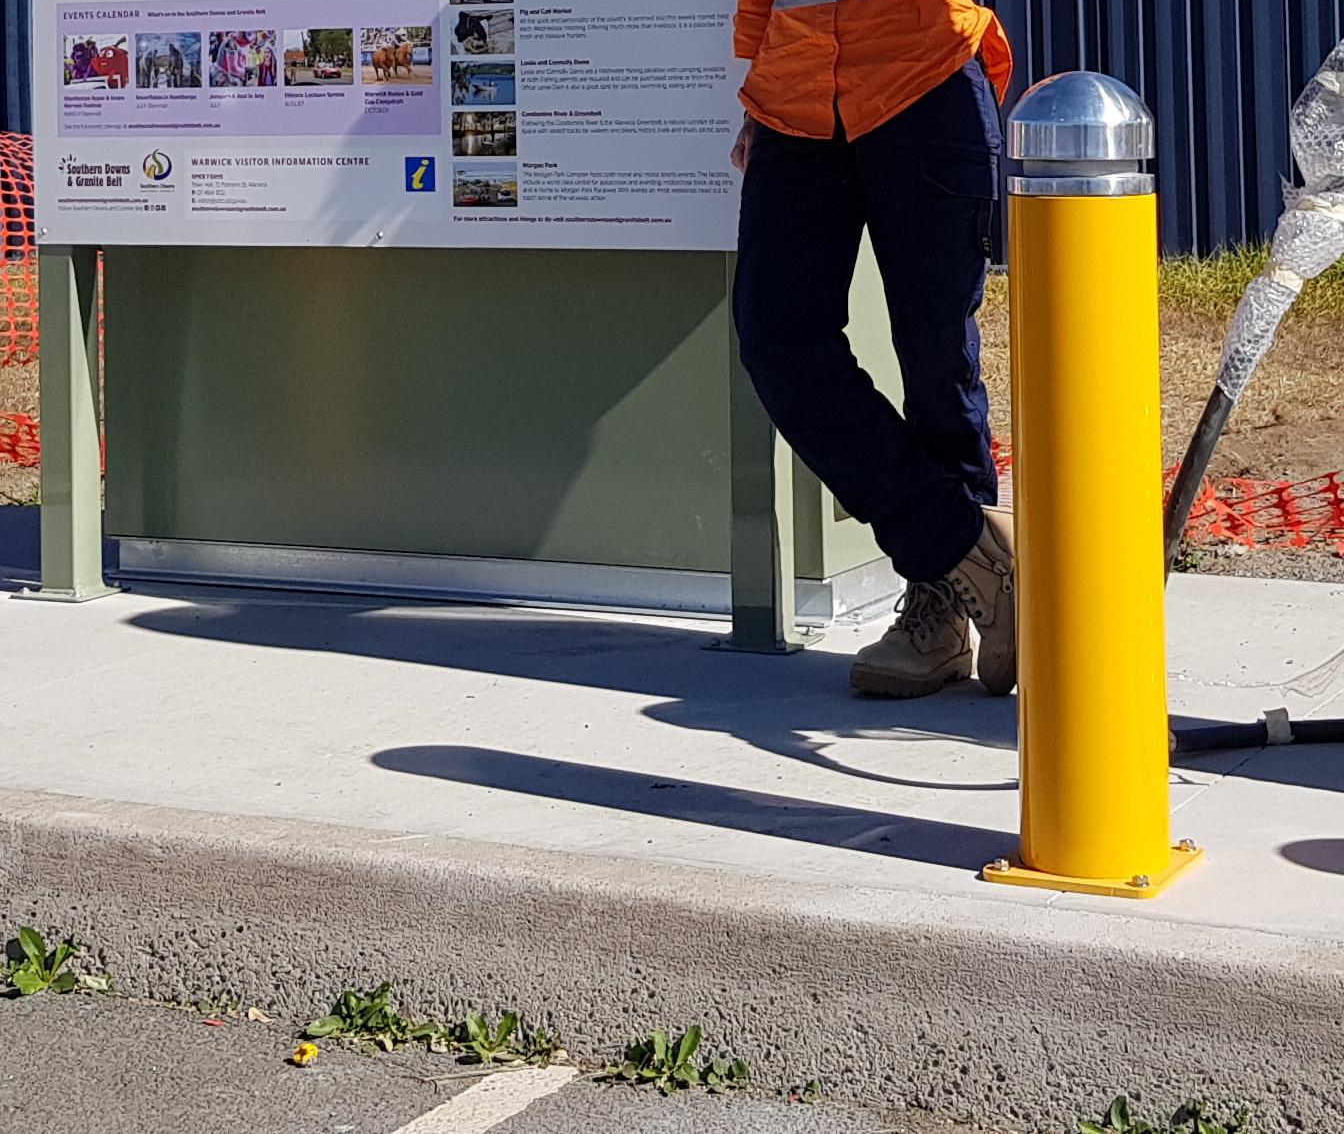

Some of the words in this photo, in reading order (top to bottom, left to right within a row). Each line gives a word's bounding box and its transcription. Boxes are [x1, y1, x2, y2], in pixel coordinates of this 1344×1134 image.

[63, 11, 94, 20] EVENTS
[96, 9, 140, 19] CALENDAR
[191, 158, 233, 166] WARWICK
[235, 158, 269, 166] VISITOR
[271, 157, 333, 166] INFORMATION
[336, 157, 370, 166] CENTRE
[67, 164, 102, 175] Southern
[106, 164, 130, 174] Downs
[67, 176, 73, 187] &
[75, 176, 104, 186] Granite
[107, 176, 123, 186] Belt
